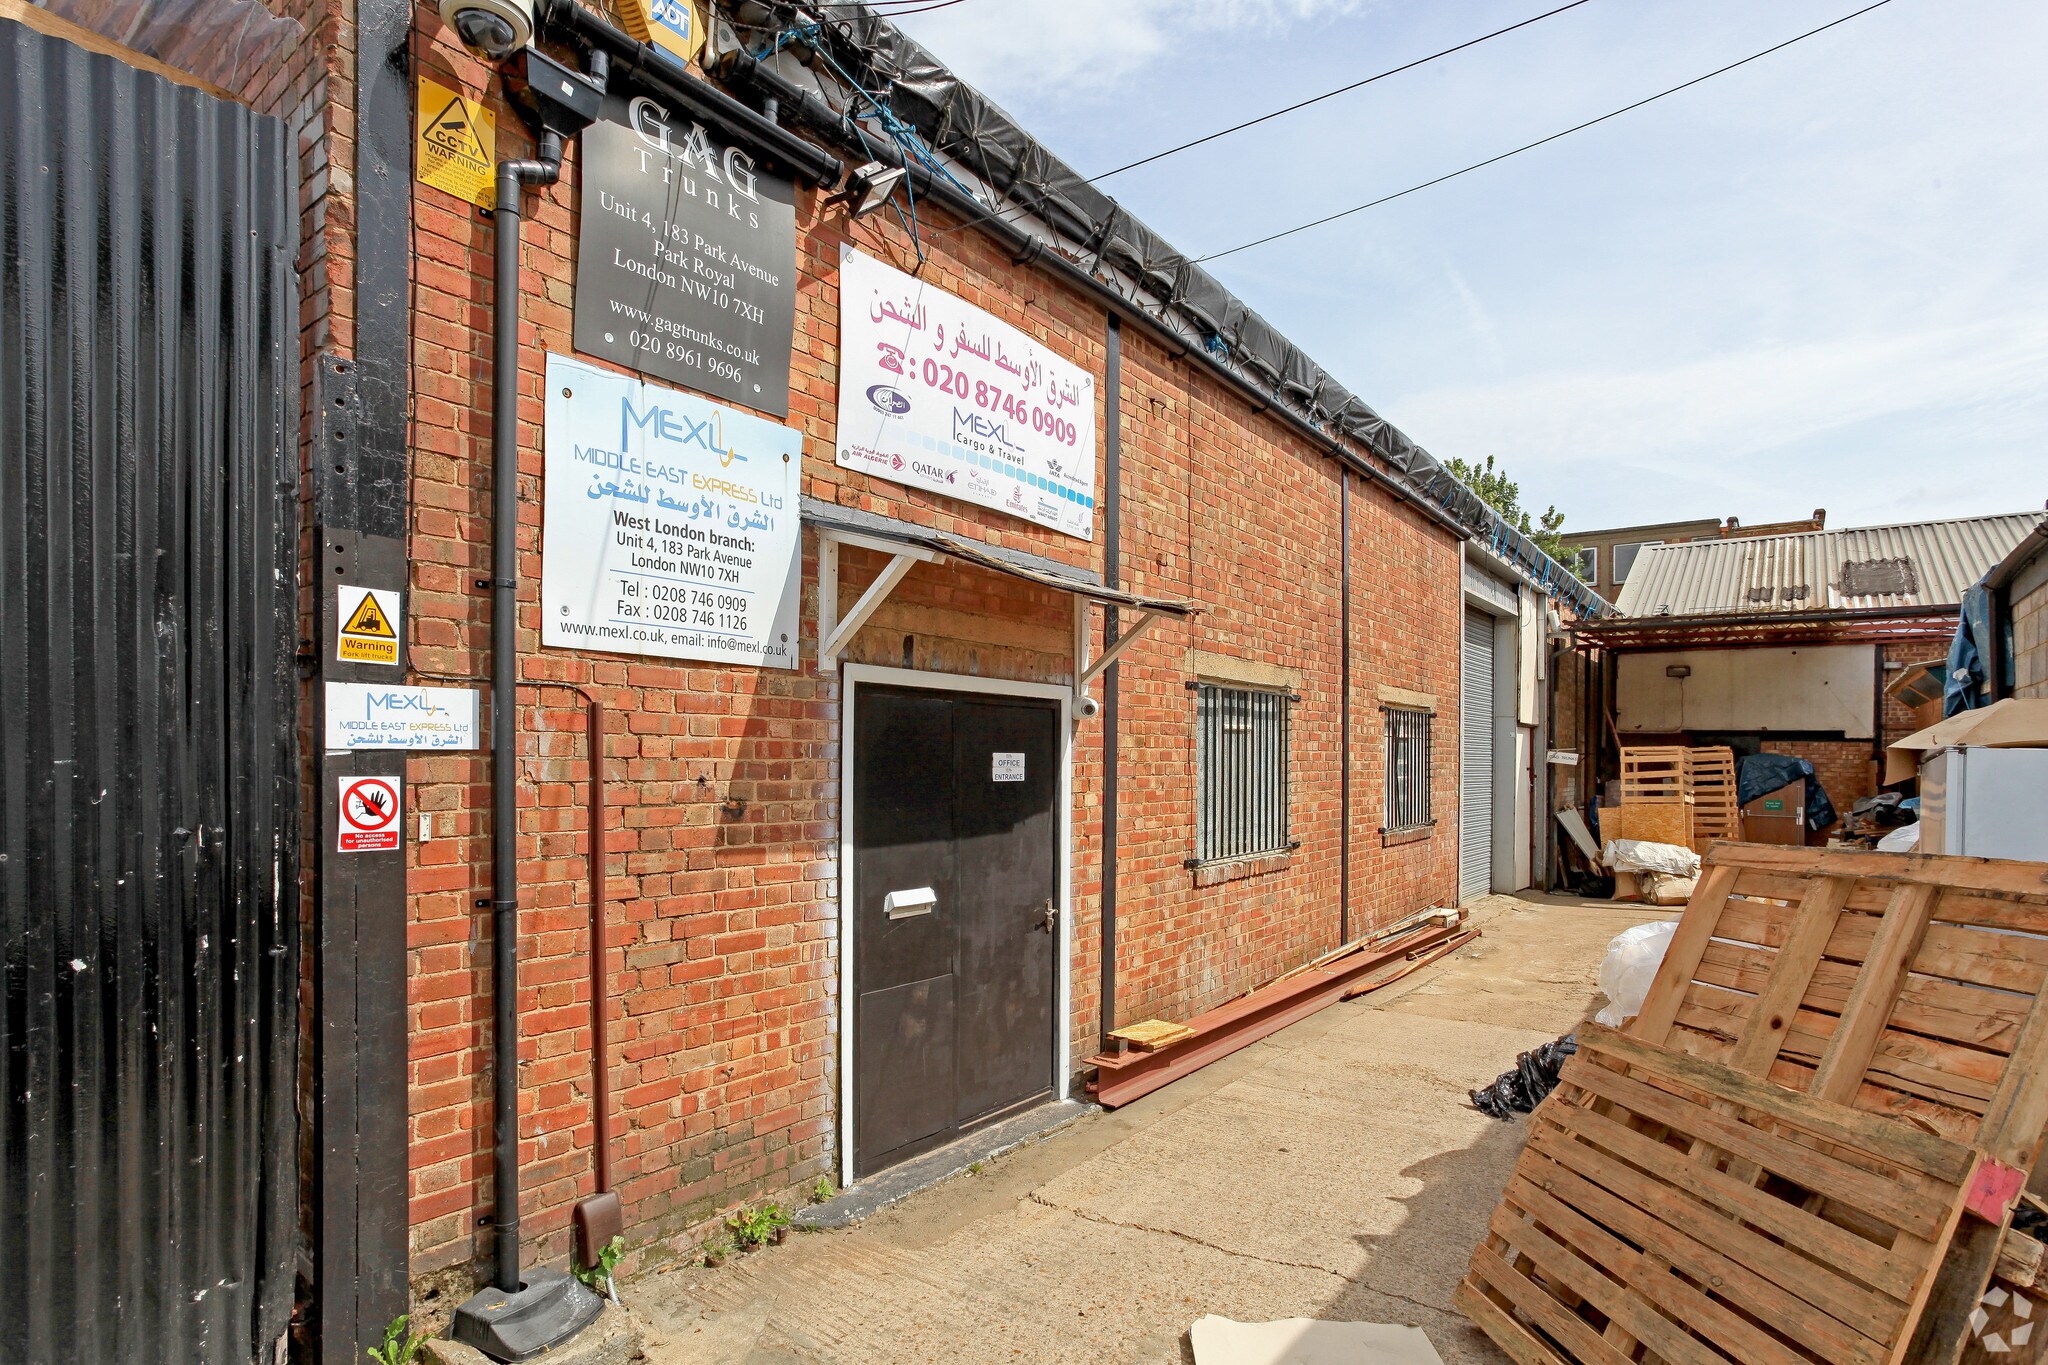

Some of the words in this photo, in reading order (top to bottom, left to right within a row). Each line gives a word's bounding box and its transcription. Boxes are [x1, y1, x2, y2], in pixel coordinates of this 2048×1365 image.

[653, 0, 689, 31] ADT
[427, 142, 486, 175] WARNING
[435, 131, 479, 157] CCTV
[629, 96, 760, 205] GAG
[634, 147, 759, 229] Trunks
[600, 191, 637, 222] Unit
[641, 212, 656, 233] 4,
[664, 221, 689, 245] 183
[694, 234, 727, 263] Park
[730, 254, 779, 286] Avenue
[654, 240, 689, 269] Park
[694, 257, 735, 289] Royal
[613, 248, 676, 288] London
[681, 275, 728, 309] NW10
[733, 299, 764, 325] 7XH
[870, 289, 926, 331] الشحن
[610, 300, 760, 365] www.gagtrunks.co.uk
[933, 324, 944, 351] و
[949, 322, 991, 361] للسفر
[630, 330, 660, 354] 020
[666, 342, 701, 369] 8961
[708, 358, 742, 383] 9696
[923, 358, 969, 399] 020
[975, 380, 1027, 424] 8746
[1032, 407, 1076, 446] 0909
[1046, 371, 1080, 409] الشرق
[622, 396, 748, 462] MEXL
[953, 406, 1025, 452] MEXL
[957, 433, 985, 451] Cargo
[989, 445, 995, 454] &
[998, 448, 1024, 466] Travel
[574, 444, 641, 474] MIDDLE
[646, 462, 688, 485] EAST
[692, 473, 758, 503] EXPRESS
[761, 492, 783, 510] Ltd
[912, 461, 943, 478] QATAR
[587, 474, 650, 504] للشحن
[656, 488, 720, 520] الأوسط
[614, 510, 650, 531] West
[655, 519, 705, 542] London
[710, 529, 755, 552] branch:
[727, 504, 775, 532] الشرق
[617, 531, 643, 548] Unit
[646, 537, 657, 553] 4,
[662, 540, 683, 555] 183
[688, 544, 710, 561] Park
[713, 550, 752, 569] Avenue
[631, 552, 676, 572] London
[680, 561, 714, 579] NW10
[718, 568, 739, 583] 7XH
[620, 580, 639, 597] Tel
[653, 585, 686, 603] 0208
[691, 590, 713, 607] 746
[718, 595, 747, 612] 0909
[617, 600, 640, 617] Fax
[654, 605, 687, 622] 0208
[692, 610, 714, 626] 746
[719, 614, 747, 630] 1126
[345, 639, 393, 654] Warning
[560, 622, 667, 645] www.mexl.co.uk,
[671, 633, 705, 647] email:
[707, 635, 787, 656] info@mexl.co.uk
[367, 692, 445, 720] MEXL
[339, 721, 378, 730] MIDDLE
[381, 722, 406, 731] EAST
[409, 722, 451, 731] EXPRESS
[454, 723, 469, 732] Ltd
[347, 733, 384, 747] للشحن
[431, 734, 463, 747] الشرق
